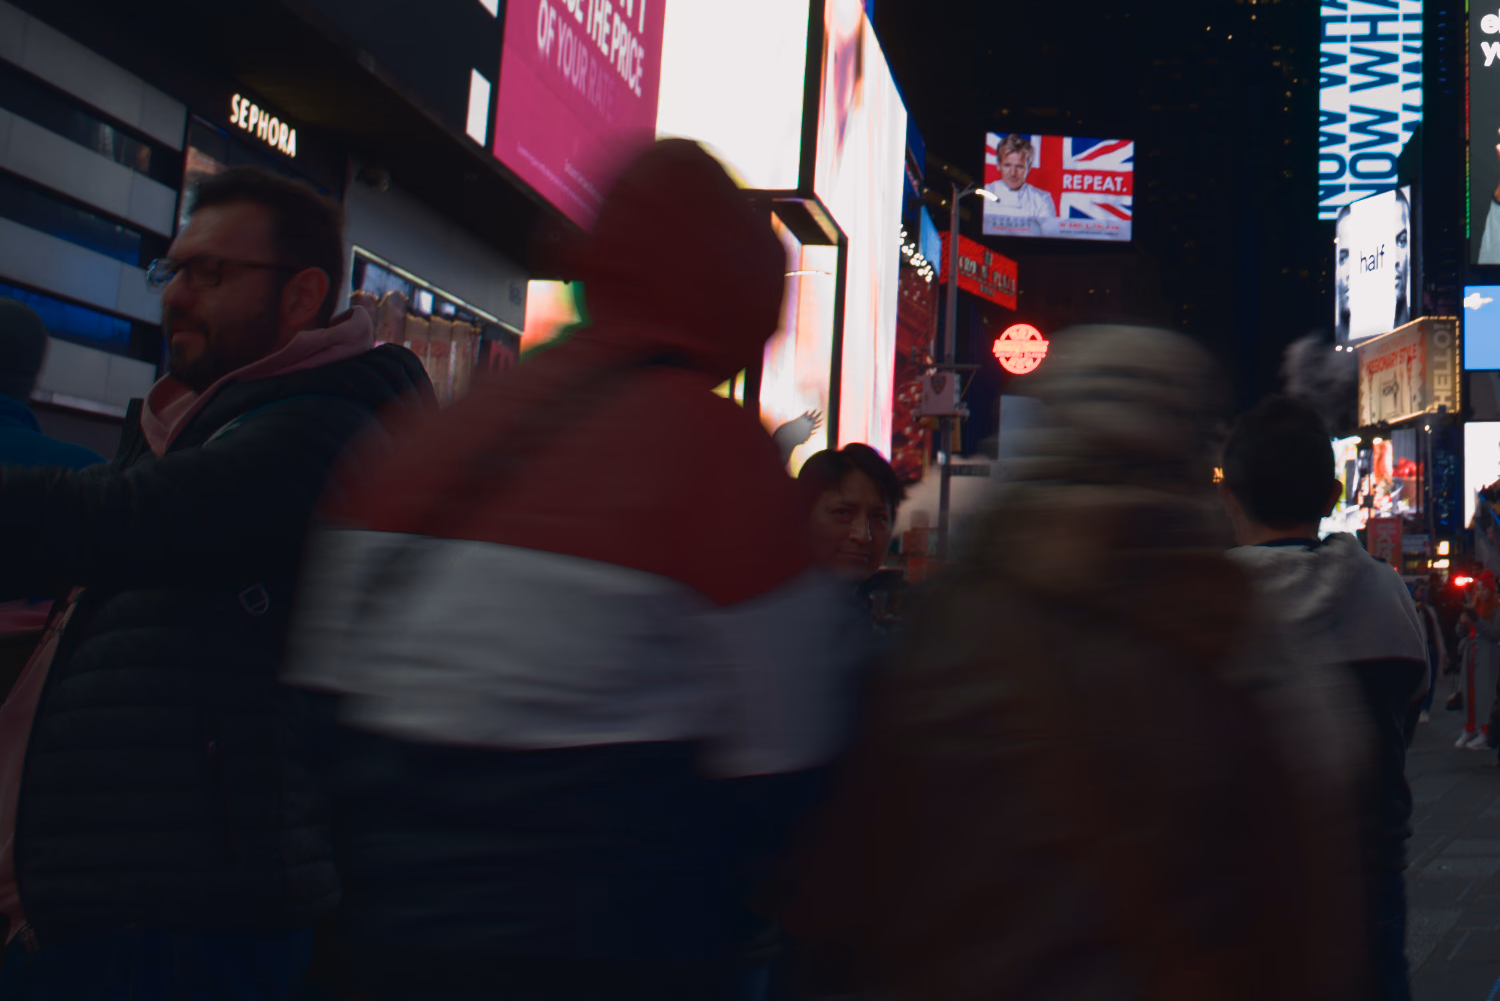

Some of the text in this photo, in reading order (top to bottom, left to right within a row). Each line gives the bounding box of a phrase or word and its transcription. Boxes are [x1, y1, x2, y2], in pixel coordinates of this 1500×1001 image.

[556, 14, 591, 96] YOUR
[609, 11, 645, 99] PRICE
[229, 92, 297, 158] SEPHORA
[1349, 104, 1399, 204] NOW
[1062, 173, 1128, 193] REPEAT.
[1360, 243, 1386, 275] half
